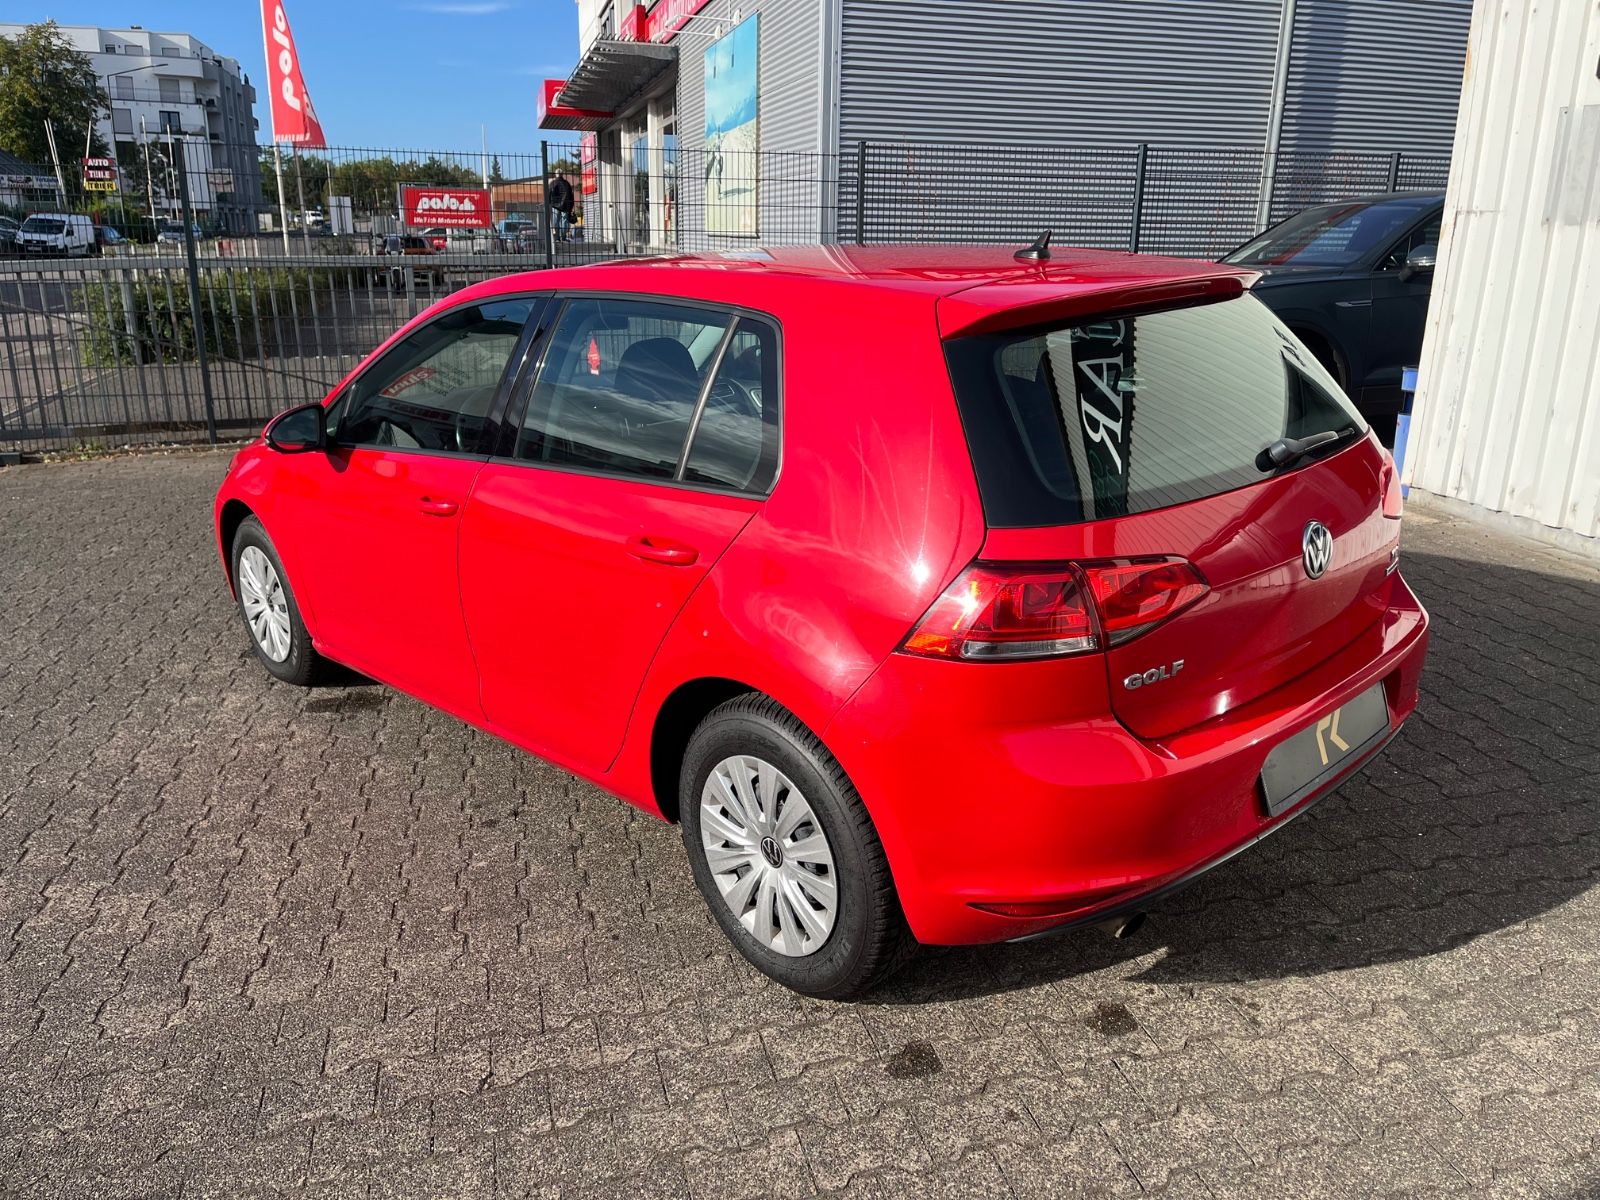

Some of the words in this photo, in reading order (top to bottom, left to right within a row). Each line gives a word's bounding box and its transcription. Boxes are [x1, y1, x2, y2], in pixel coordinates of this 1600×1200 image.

[272, 4, 301, 112] polo
[88, 158, 109, 166] AUTO
[417, 193, 459, 213] polo
[1123, 659, 1185, 690] GOLF
